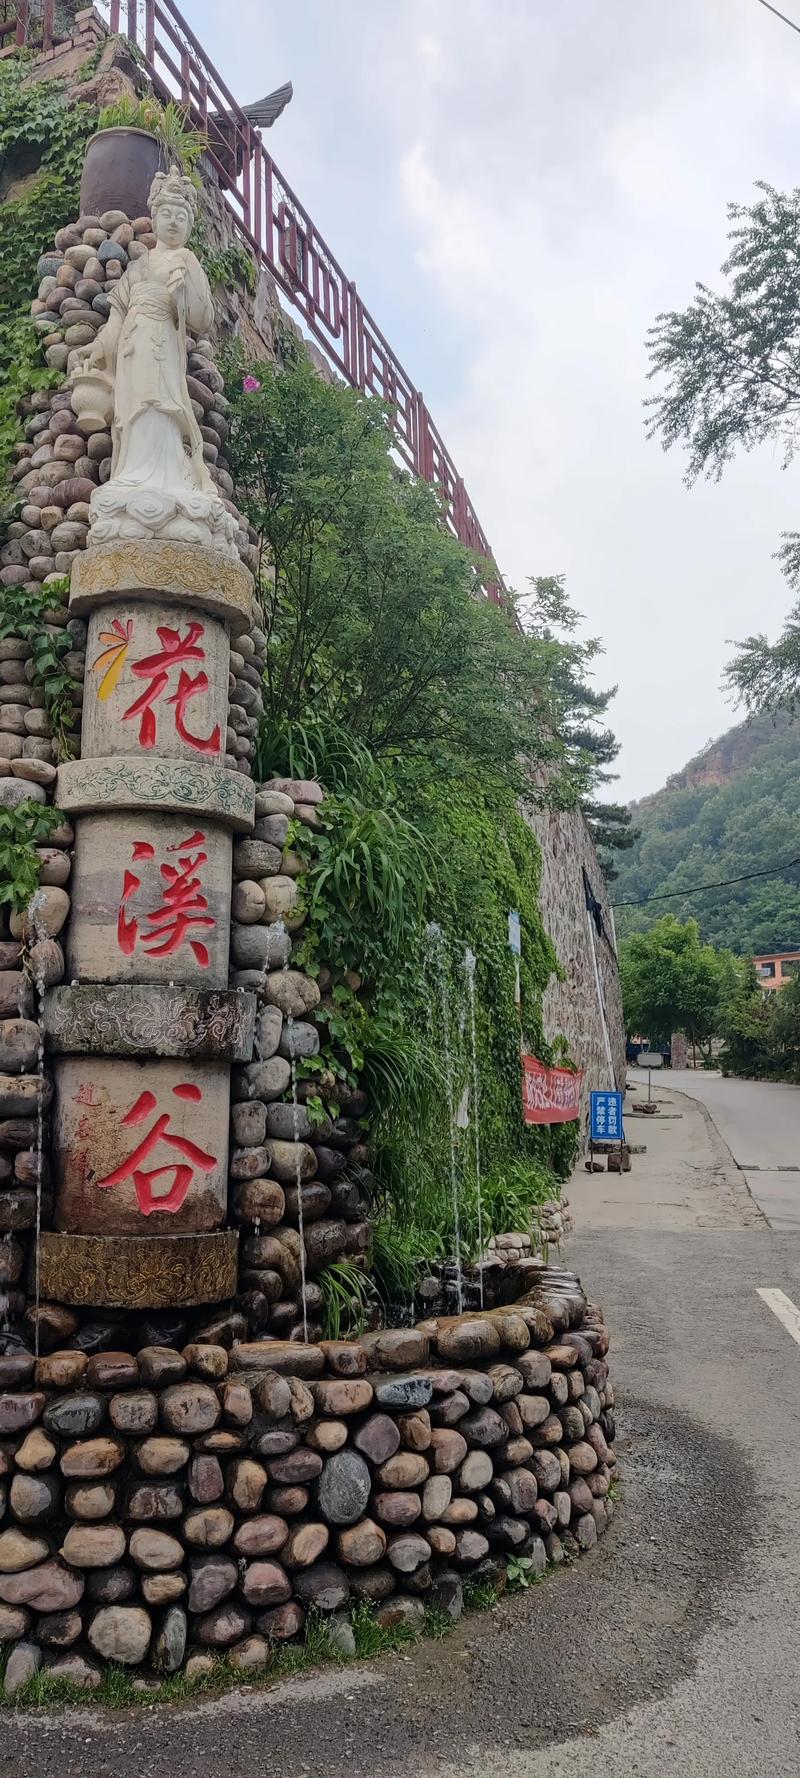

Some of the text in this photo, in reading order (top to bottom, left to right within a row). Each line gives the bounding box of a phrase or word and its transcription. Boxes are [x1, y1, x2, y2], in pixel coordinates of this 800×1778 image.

[97, 622, 221, 1216] 花溪谷
[596, 1096, 606, 1135] 严禁停车
[607, 1097, 618, 1135] 违者罚款
